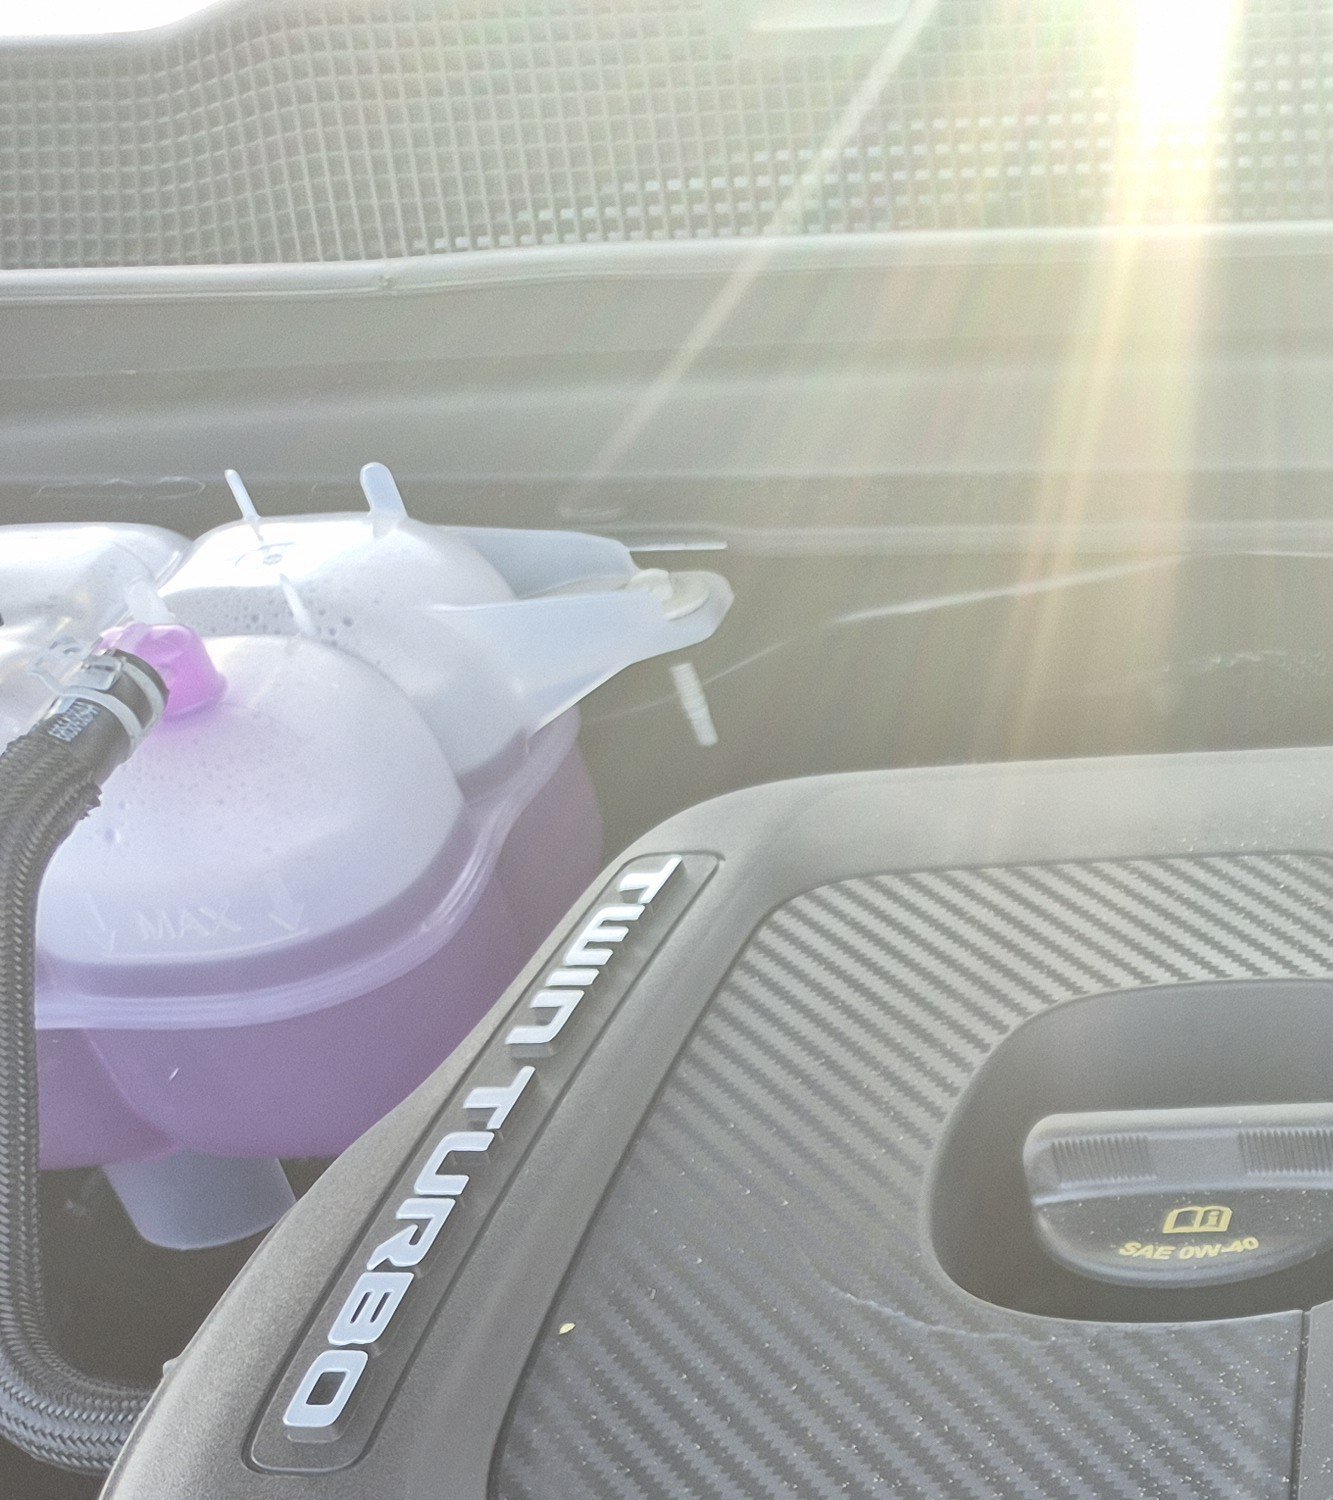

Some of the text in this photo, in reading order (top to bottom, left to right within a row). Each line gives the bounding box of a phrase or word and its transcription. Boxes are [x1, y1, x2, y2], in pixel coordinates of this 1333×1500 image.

[134, 905, 241, 941] MAX
[282, 855, 682, 1427] TWIN TURBO
[1119, 1242, 1176, 1260] SAE
